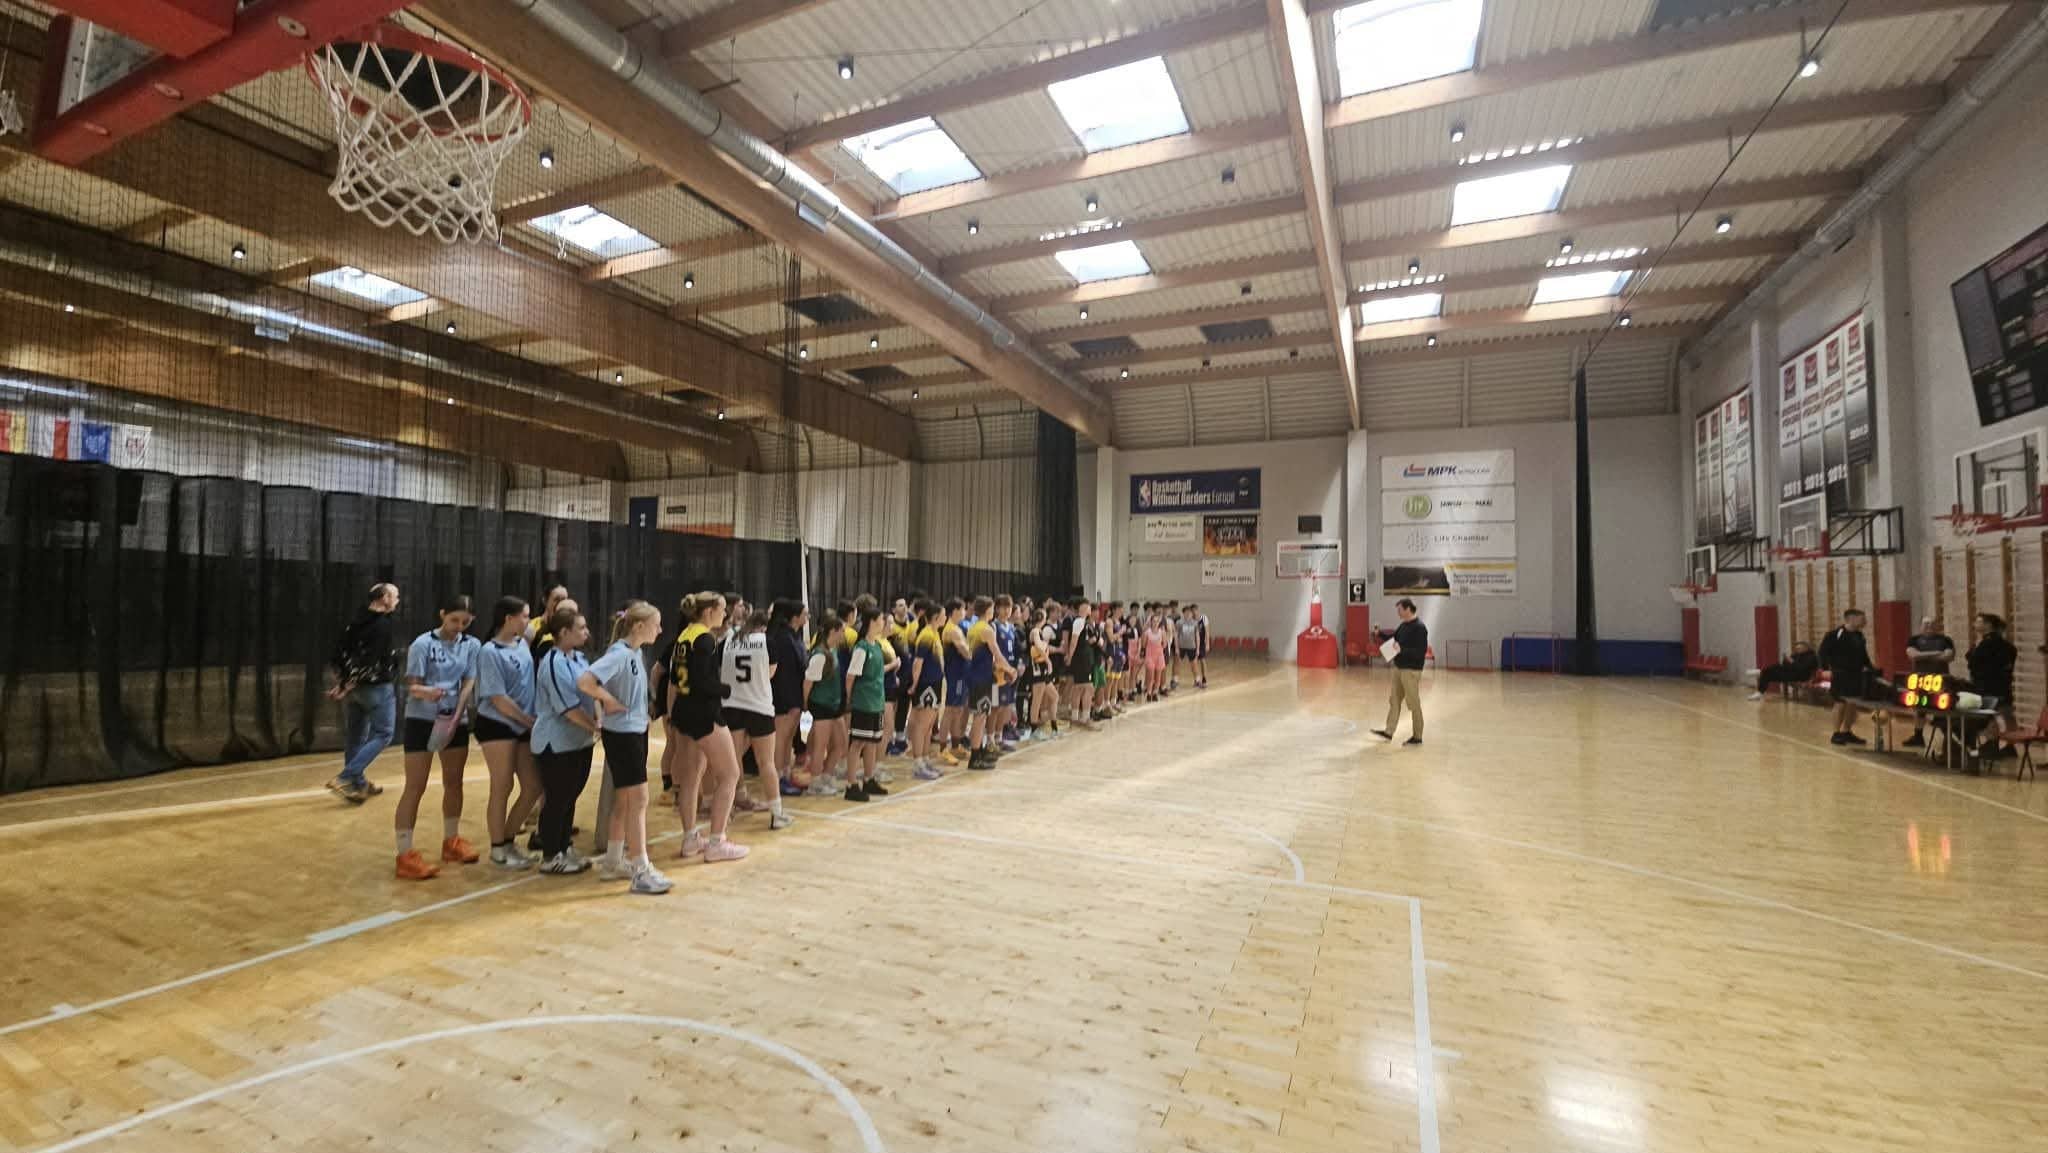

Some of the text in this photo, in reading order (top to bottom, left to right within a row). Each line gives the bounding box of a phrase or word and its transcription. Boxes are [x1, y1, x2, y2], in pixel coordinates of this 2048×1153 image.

[1428, 465, 1457, 476] MPK
[1152, 479, 1192, 492] Basketball
[1152, 491, 1180, 506] Without
[1181, 490, 1211, 505] Borders
[1212, 490, 1235, 505] Europe
[735, 655, 752, 683] 5
